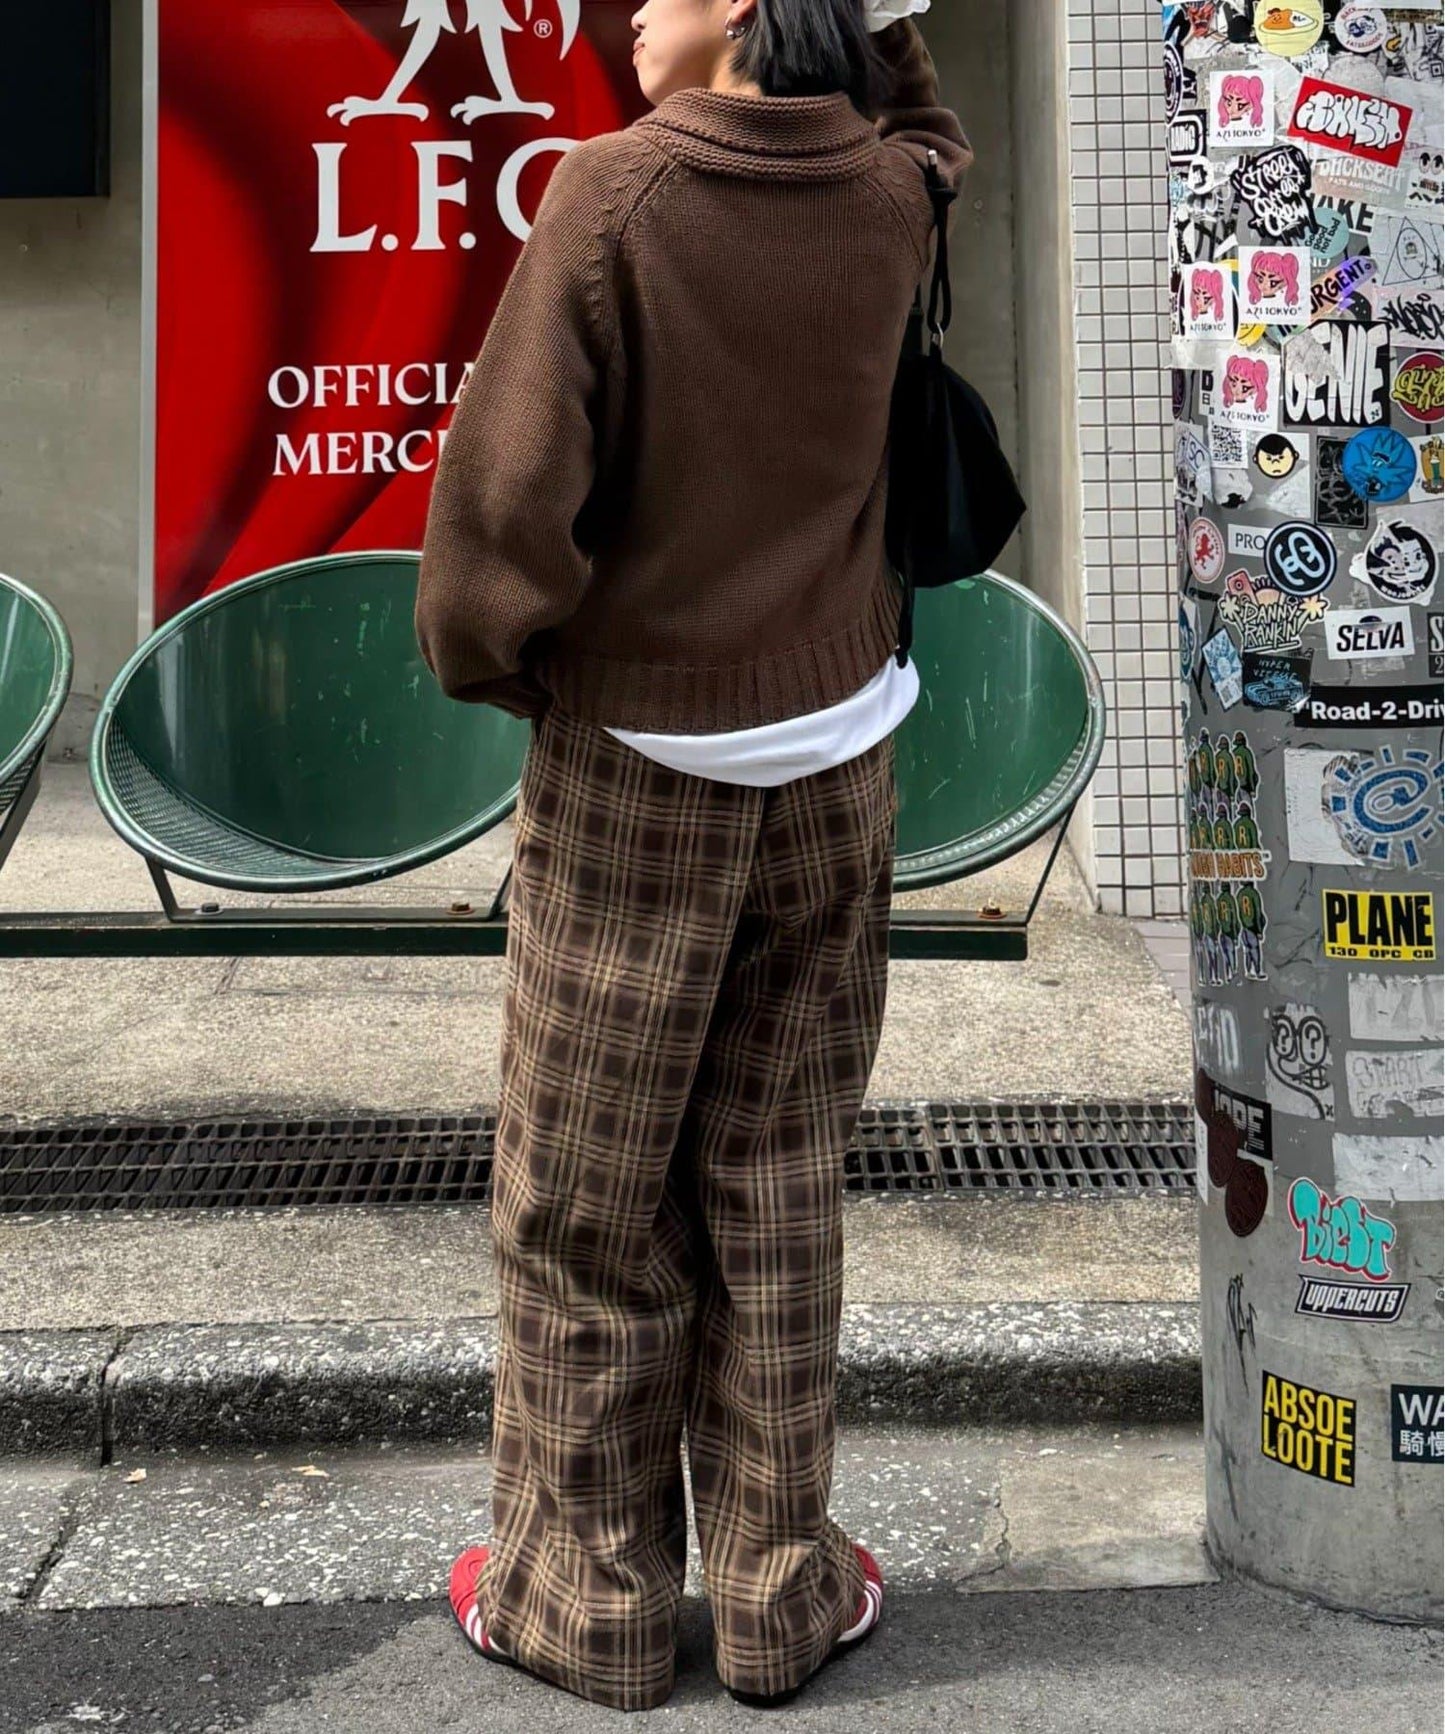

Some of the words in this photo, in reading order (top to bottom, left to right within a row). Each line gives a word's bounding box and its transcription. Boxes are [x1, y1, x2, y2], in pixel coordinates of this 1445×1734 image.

[1328, 217, 1341, 237] bad
[272, 429, 449, 476] MERC
[1235, 532, 1266, 551] PRO
[1243, 602, 1298, 624] DANNY
[1244, 618, 1297, 648] RANKIN
[1336, 621, 1405, 652] SELVA
[1306, 698, 1444, 720] "Road-2-Dri
[1325, 892, 1434, 947] PLANE
[1263, 1375, 1354, 1442] ABSOE
[1263, 1414, 1353, 1484] LOOTE
